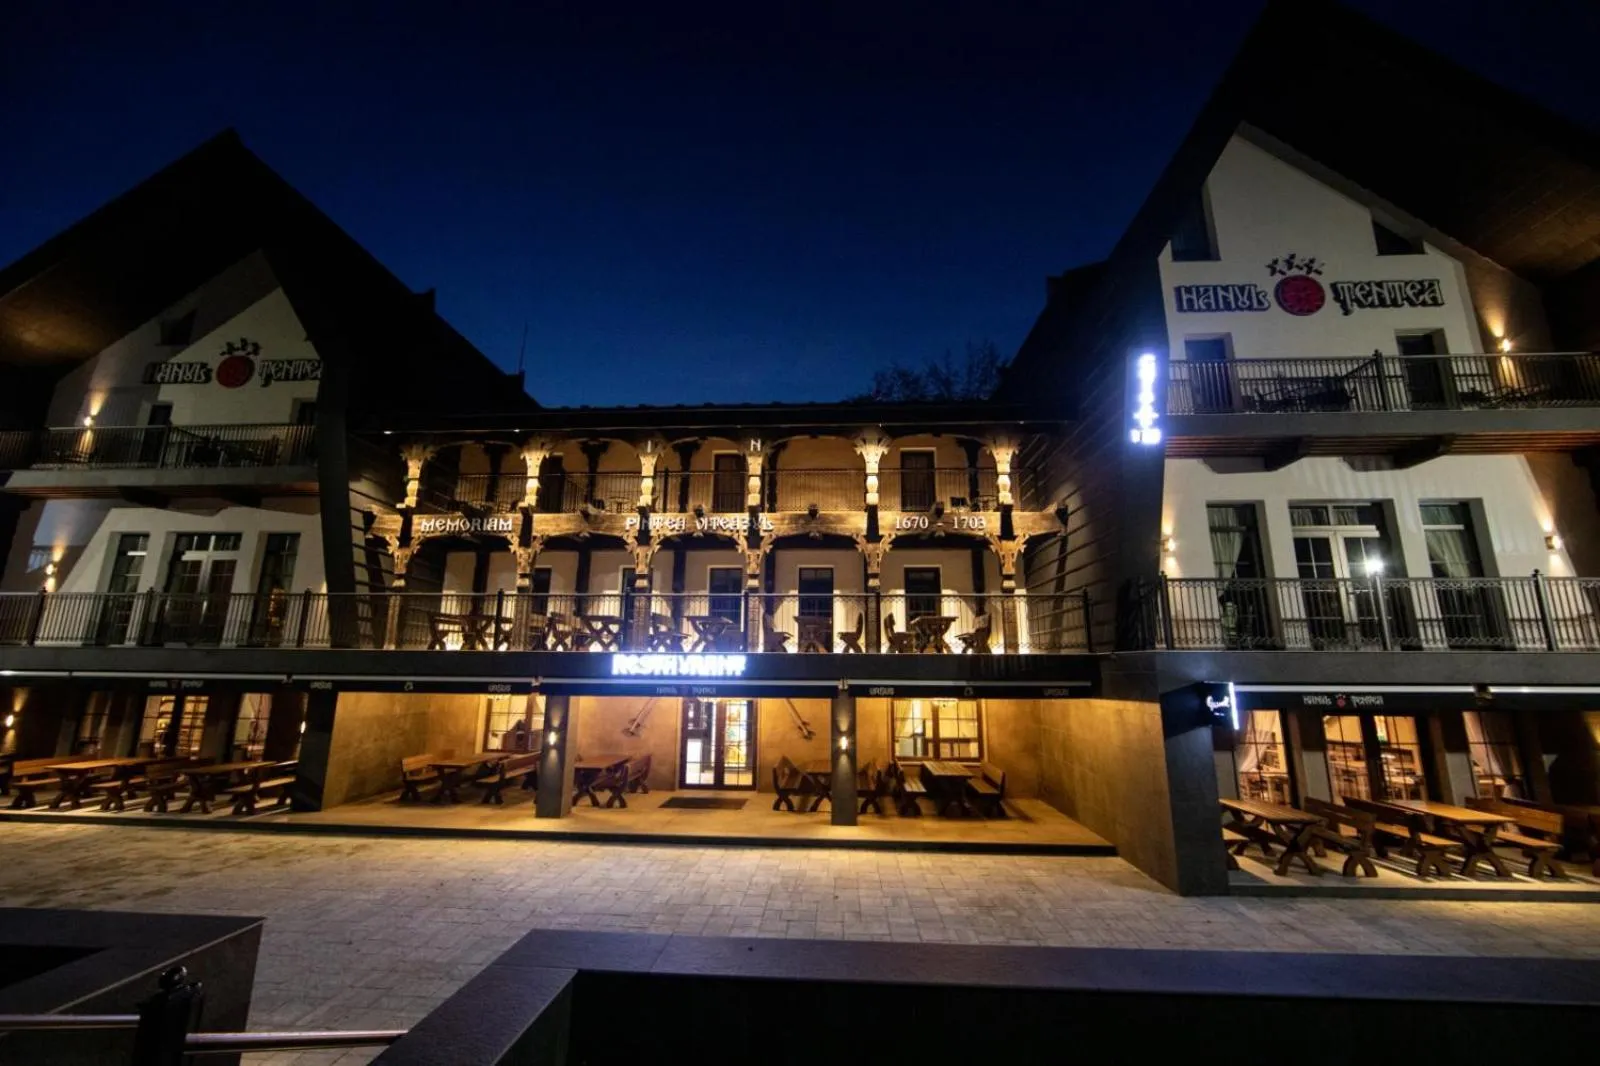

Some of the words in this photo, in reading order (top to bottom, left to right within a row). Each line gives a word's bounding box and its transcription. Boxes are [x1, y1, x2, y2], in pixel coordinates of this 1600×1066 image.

[1330, 279, 1445, 315] TENTEA
[420, 516, 514, 532] MEMORIAM
[625, 516, 687, 531] PINTEA
[894, 515, 929, 530] 1670
[952, 515, 987, 530] 1703
